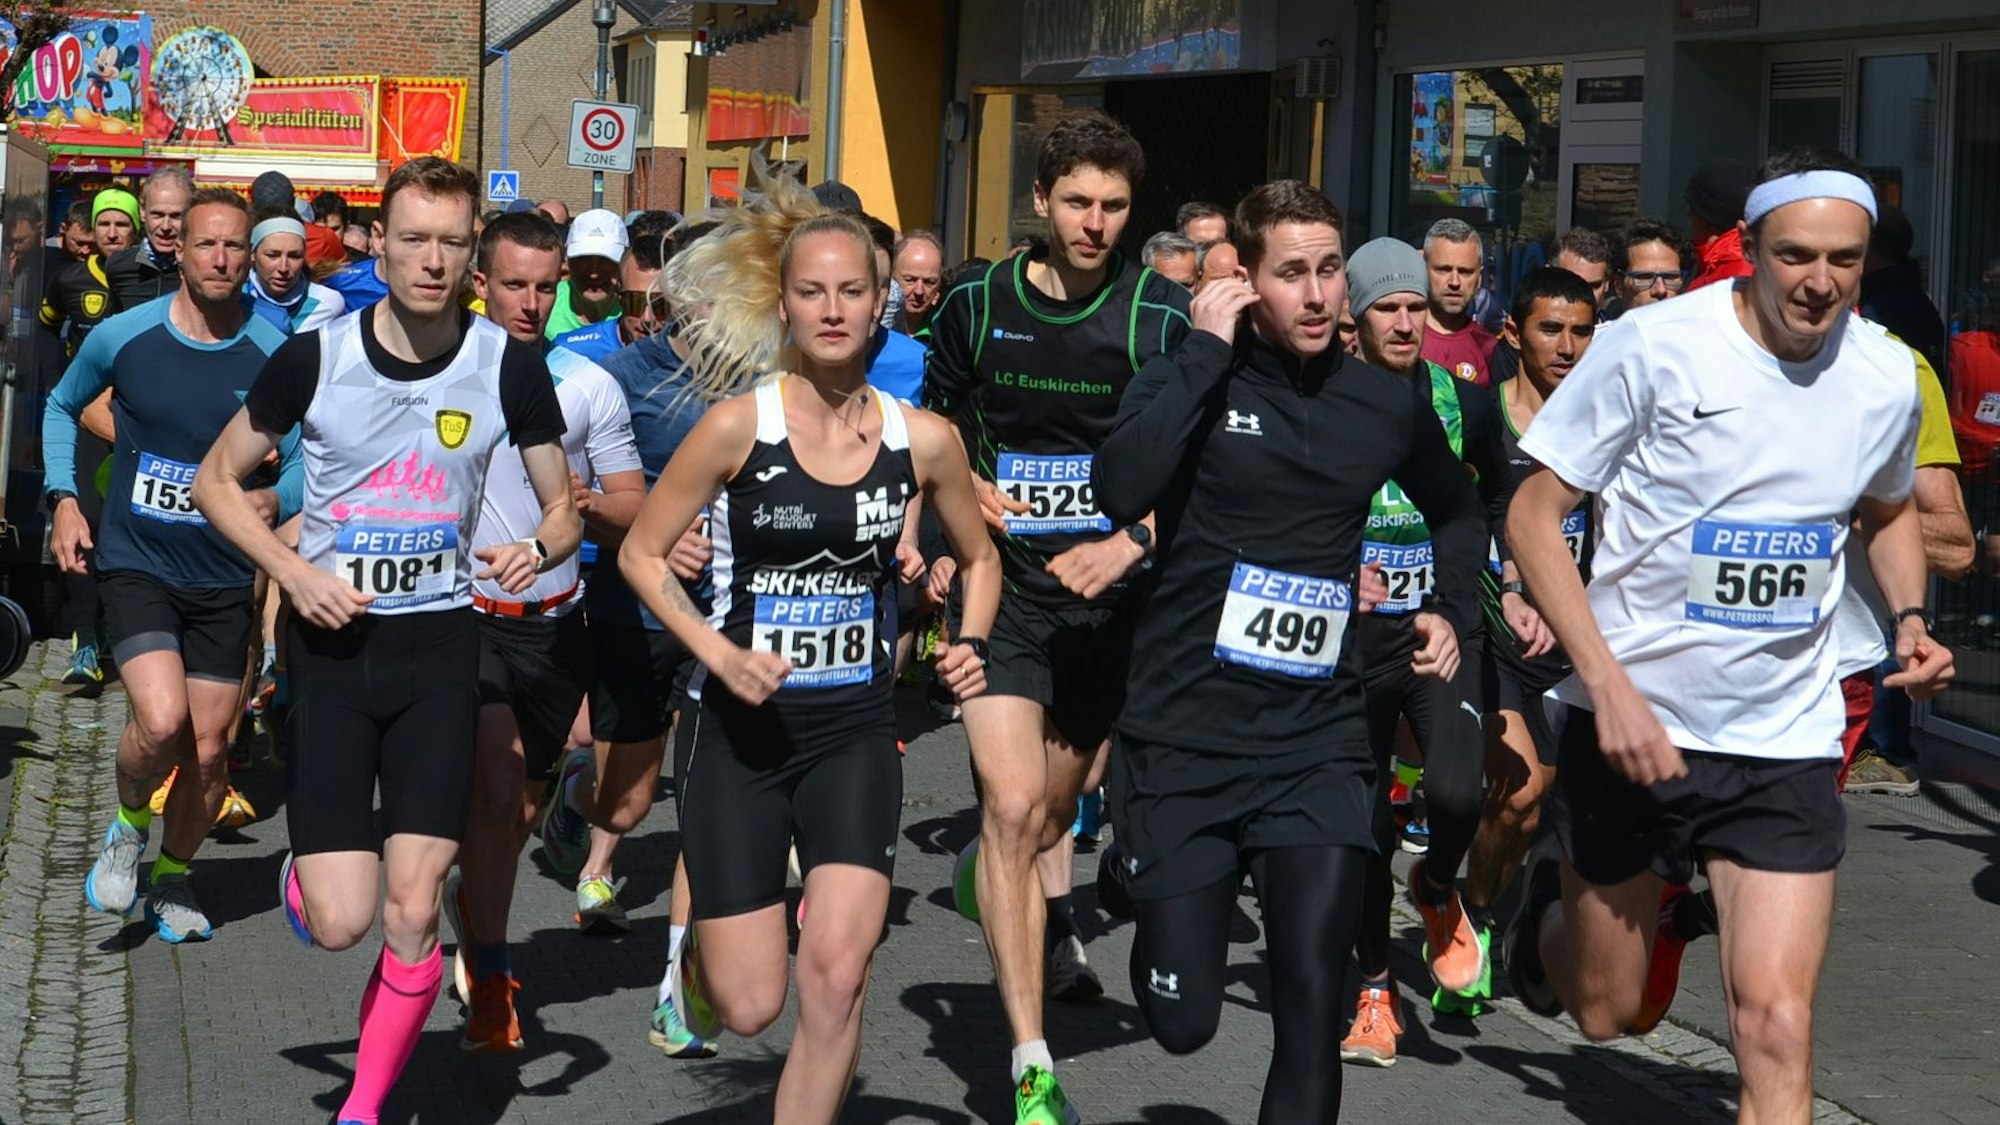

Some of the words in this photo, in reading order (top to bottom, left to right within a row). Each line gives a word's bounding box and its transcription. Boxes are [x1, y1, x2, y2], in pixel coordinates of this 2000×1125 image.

[4, 34, 83, 110] HOP
[236, 104, 362, 132] Spezialitäten
[590, 119, 616, 140] 30
[583, 152, 617, 166] ZONE
[995, 370, 1013, 386] LC
[1018, 374, 1112, 394] Euskirchen
[391, 396, 429, 406] FUSION
[443, 419, 463, 434] TuS
[148, 459, 196, 483] PETE
[1010, 459, 1092, 479] PETERS
[143, 478, 195, 512] 153
[1006, 483, 1101, 518] 1529
[773, 520, 814, 530] CENTERS
[353, 529, 445, 552] PETERS
[1710, 529, 1820, 556] PETERS
[1363, 546, 1434, 566] PETERS
[346, 553, 443, 594] 1081
[1715, 561, 1807, 608] 566
[1240, 568, 1348, 608] PETERS
[771, 598, 862, 624] PETERS
[1244, 606, 1328, 656] 499
[765, 625, 865, 669] 1518
